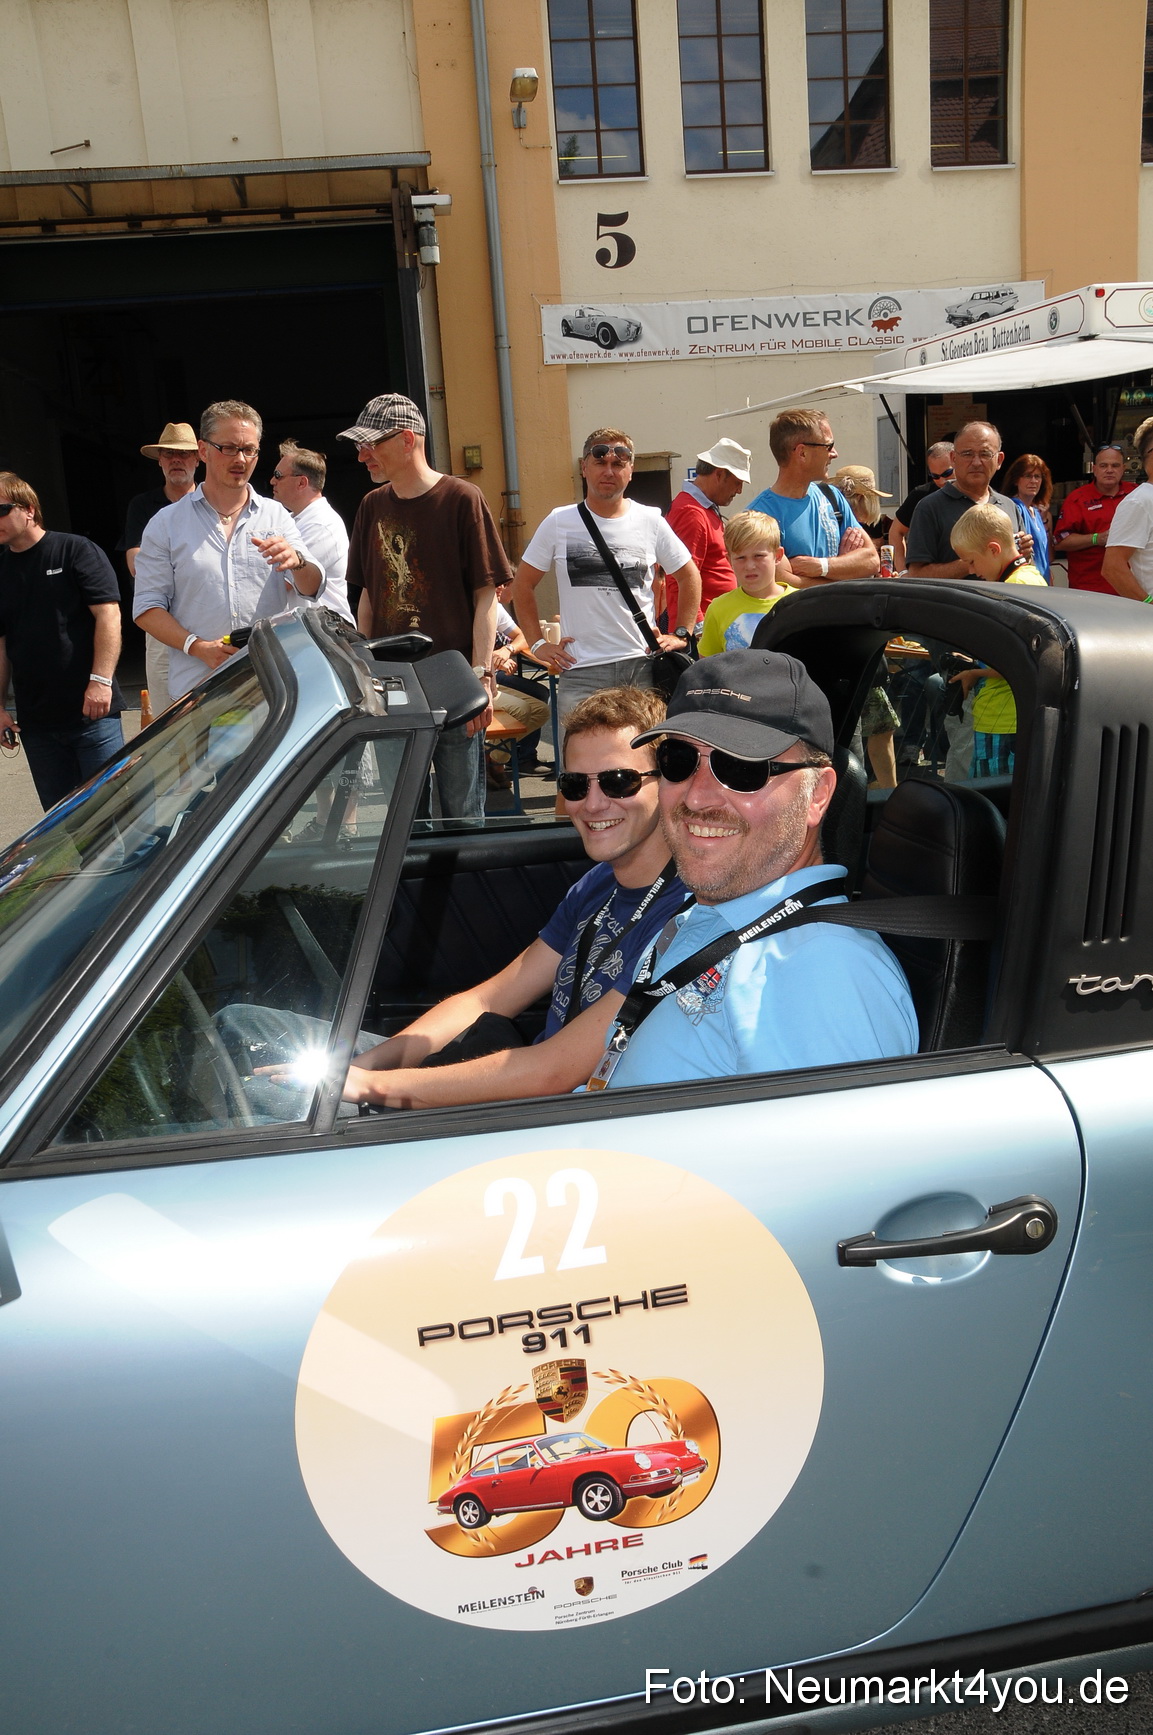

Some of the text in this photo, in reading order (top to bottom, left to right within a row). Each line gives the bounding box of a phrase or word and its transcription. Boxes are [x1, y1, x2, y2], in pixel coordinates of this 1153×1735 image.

[595, 210, 637, 269] 5
[686, 307, 865, 334] OFENWERK
[992, 320, 1031, 350] Buttenheim
[550, 348, 680, 361] www.ofenwerk.de www.ofenwerk.de
[688, 342, 755, 355] ZENTRUM
[760, 338, 786, 351] FÜR
[791, 338, 843, 349] MOBILE
[847, 335, 905, 347] CLASSIC
[685, 688, 752, 702] PORSCHE
[737, 899, 805, 944] MEILENSTEIN
[483, 1167, 608, 1281] 22
[416, 1283, 689, 1347] PORSCHE
[522, 1323, 592, 1354] 911
[514, 1533, 645, 1568] JAHRE
[621, 1565, 659, 1578] Porsche
[661, 1560, 683, 1570] Club
[553, 1593, 618, 1610] PORSCHE
